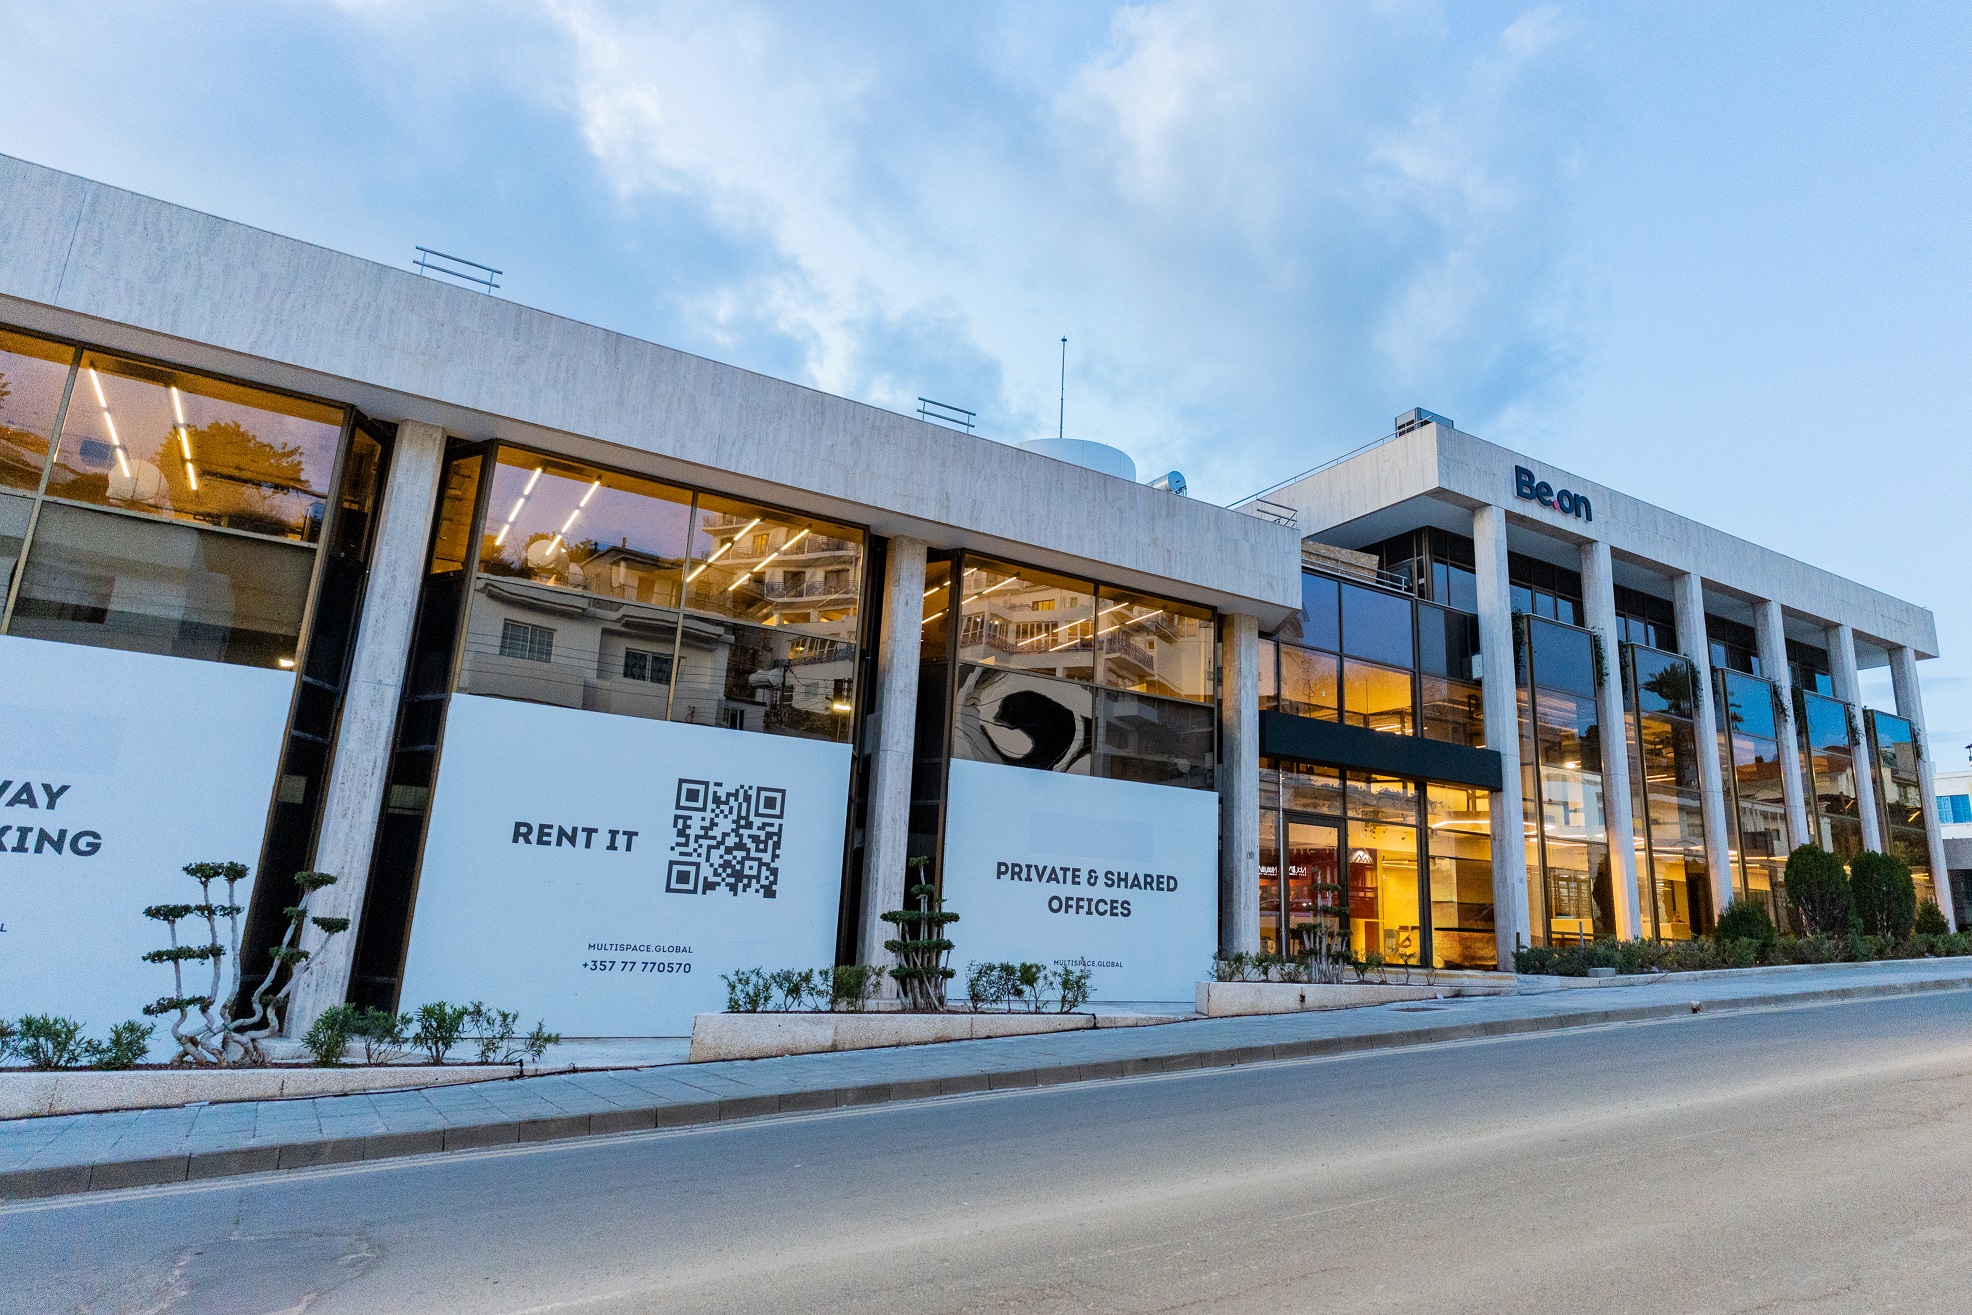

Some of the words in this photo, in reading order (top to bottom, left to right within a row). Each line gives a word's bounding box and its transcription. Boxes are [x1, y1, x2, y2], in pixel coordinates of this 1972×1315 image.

[1515, 465, 1592, 522] Be.on
[512, 821, 599, 849] RENT
[605, 828, 639, 852] IT
[996, 861, 1081, 886] PRIVATE
[1086, 868, 1099, 887] &
[1104, 870, 1178, 892] SHARED
[1047, 895, 1132, 917] OFFICES
[587, 942, 693, 954] MULTISPACE.GLOBAL
[582, 959, 615, 972] +357
[620, 960, 636, 972] 77
[641, 961, 692, 974] 770570
[1053, 959, 1123, 968] MULTISPACE.GLOBAL
